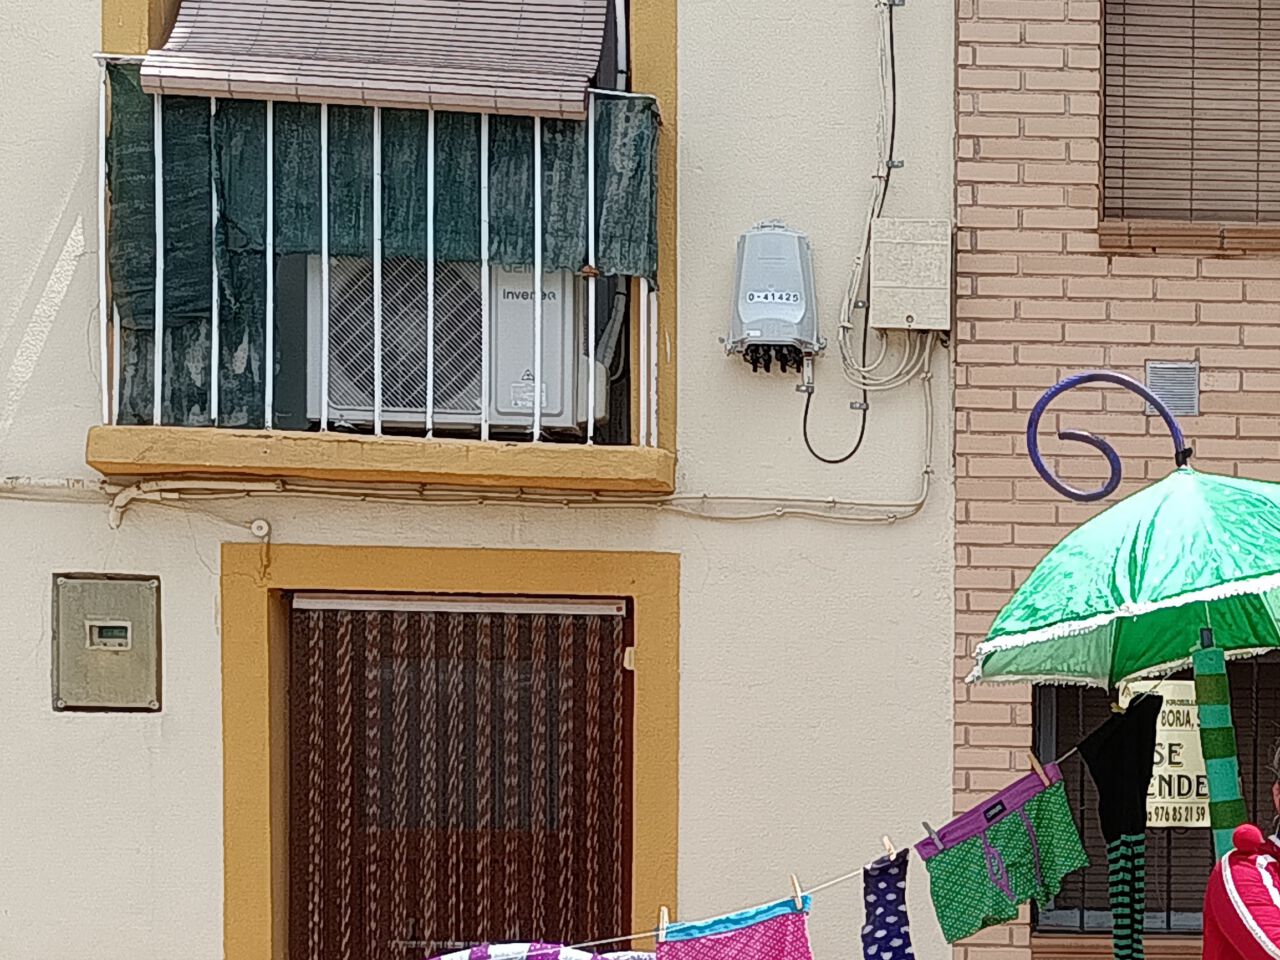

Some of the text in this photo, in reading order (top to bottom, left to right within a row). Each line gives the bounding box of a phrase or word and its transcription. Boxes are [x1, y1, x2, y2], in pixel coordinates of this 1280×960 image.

[502, 288, 556, 300] Inverer
[1153, 743, 1183, 767] SE
[1155, 806, 1170, 822] 976
[1172, 806, 1182, 822] 85
[1185, 806, 1193, 822] 21
[1196, 806, 1206, 822] 59
